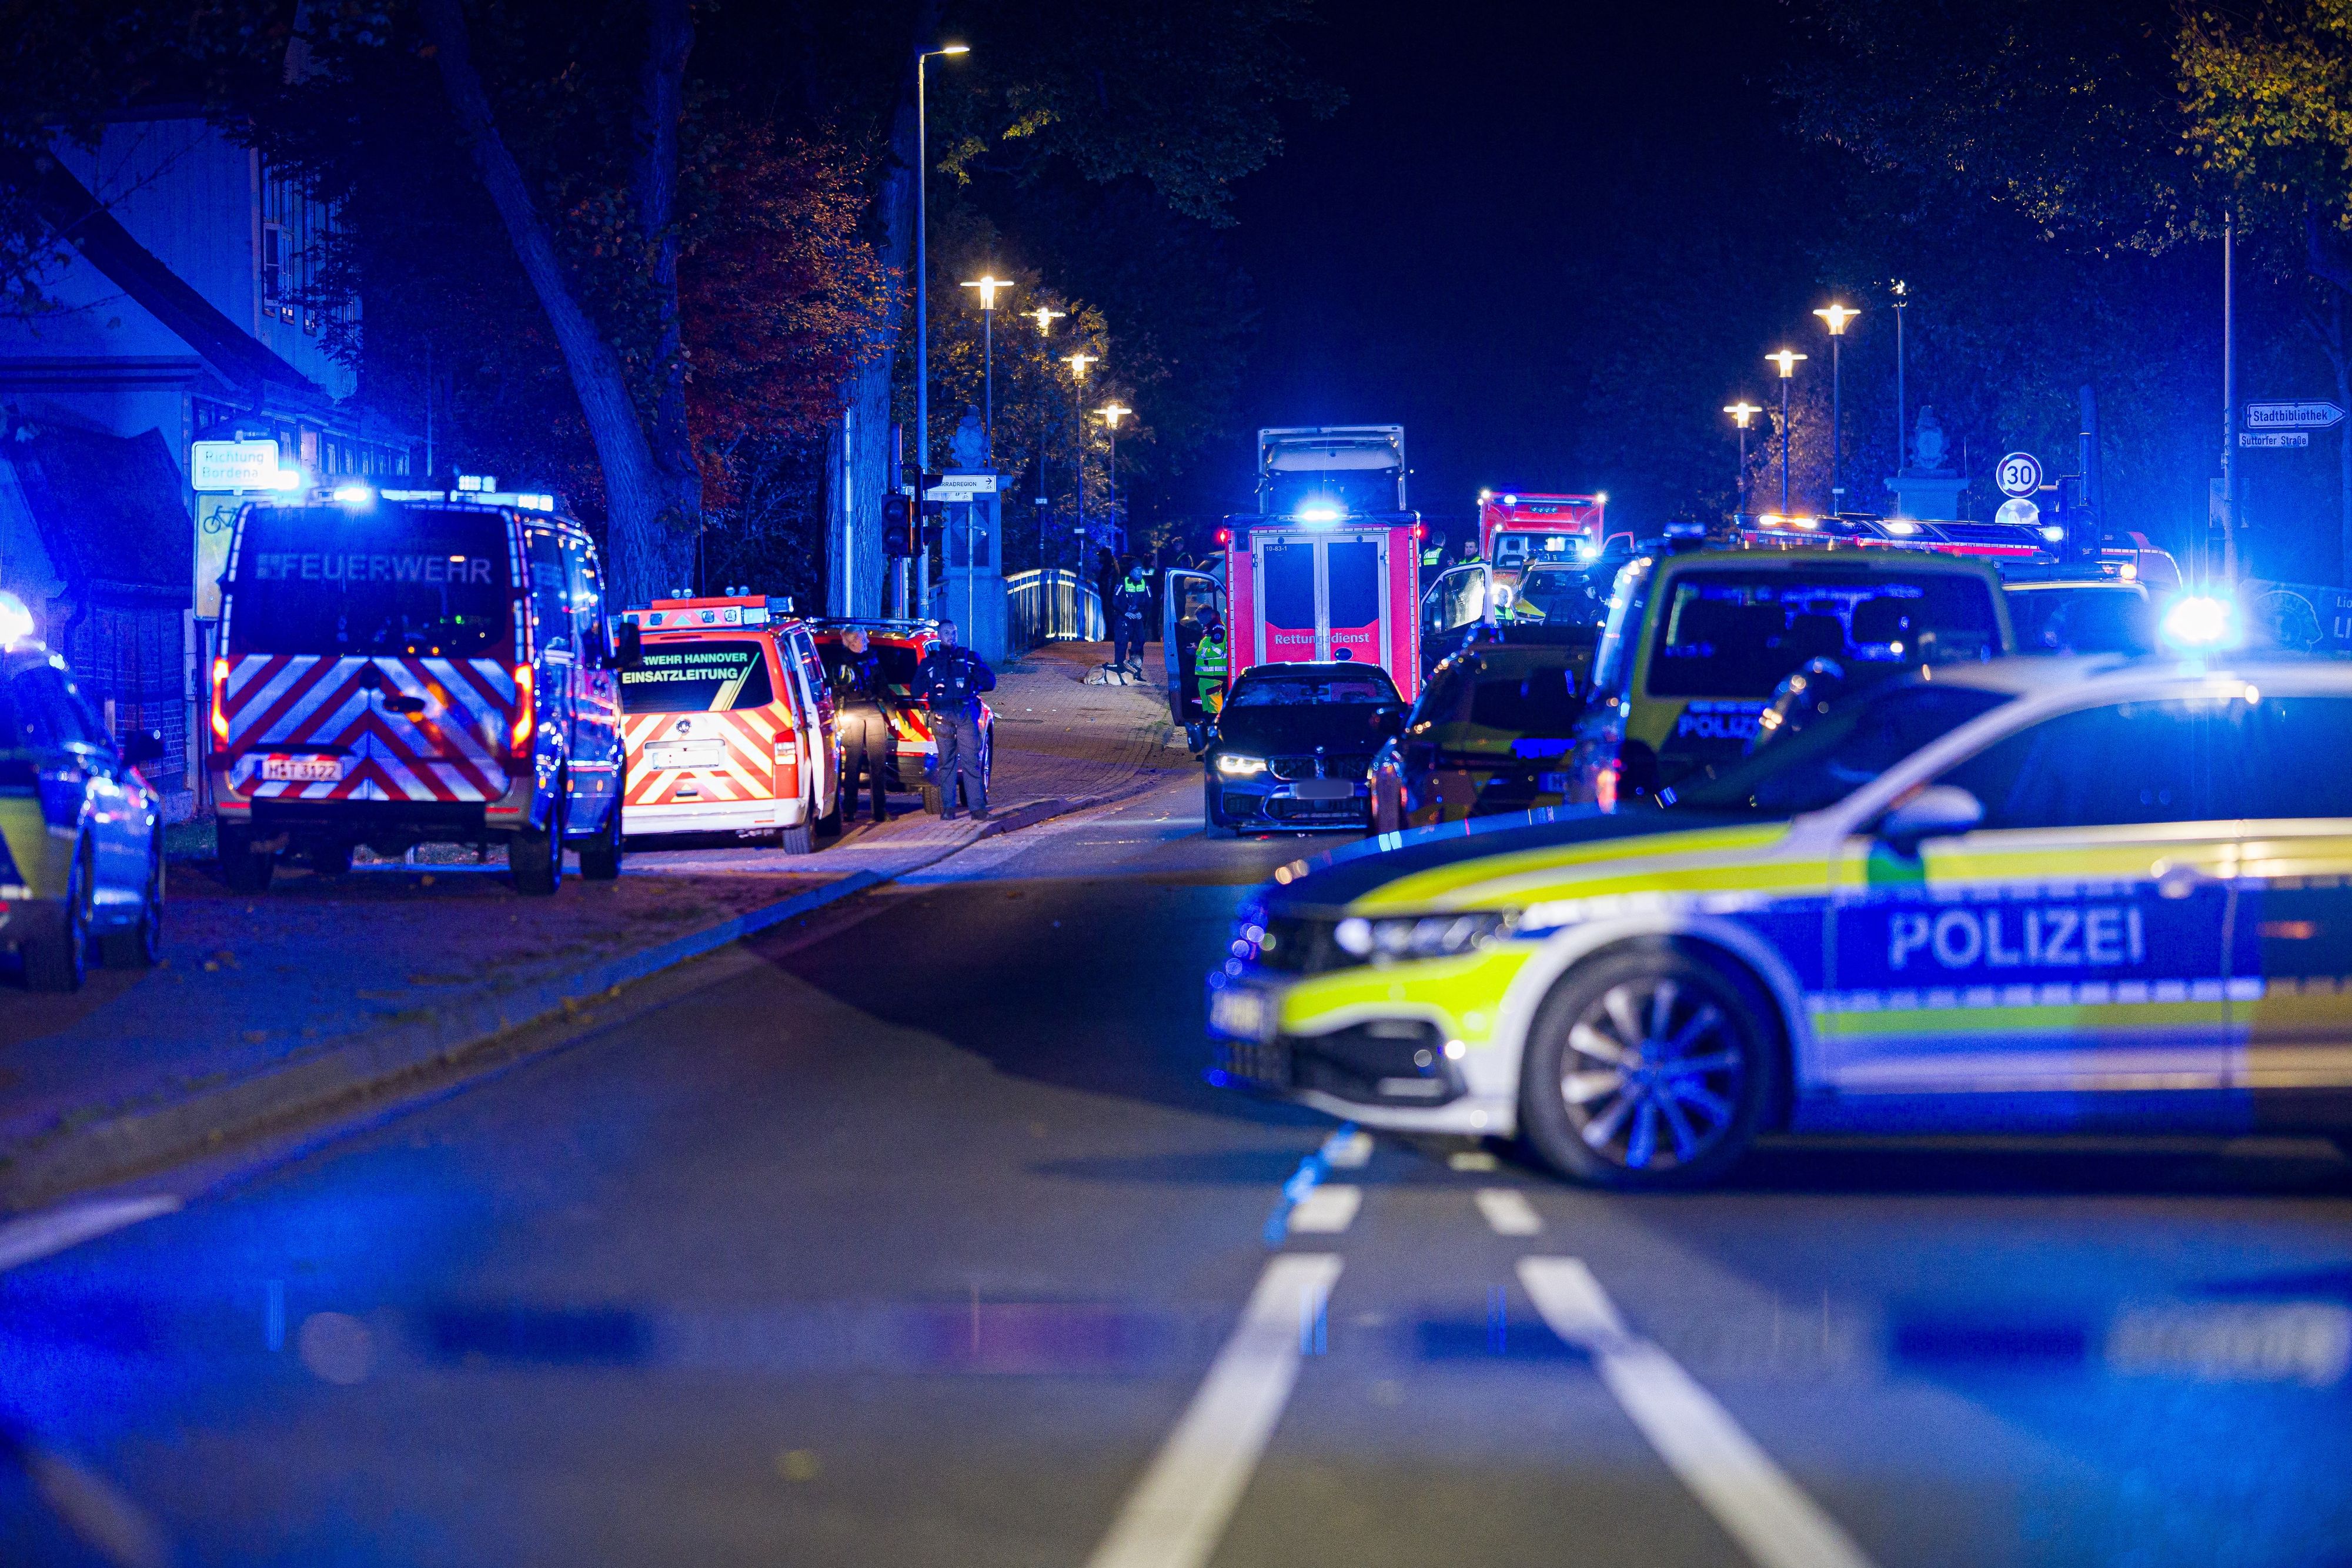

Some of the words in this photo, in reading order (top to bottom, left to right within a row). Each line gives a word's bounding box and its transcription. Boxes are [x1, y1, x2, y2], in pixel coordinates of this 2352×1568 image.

[2253, 410, 2328, 422] Stadtbibliothek
[2241, 436, 2277, 445] Suttorfer
[2281, 436, 2306, 445] Straße
[206, 451, 264, 465] Richtung
[203, 466, 259, 479] Bordena
[2007, 466, 2032, 485] 30
[282, 553, 492, 584] FEUERWEHR
[643, 654, 682, 666] RWEHR
[684, 653, 748, 664] HANNOVER
[622, 668, 738, 684] EINSATZLEITUNG
[1887, 905, 2145, 970] POLIZEI
